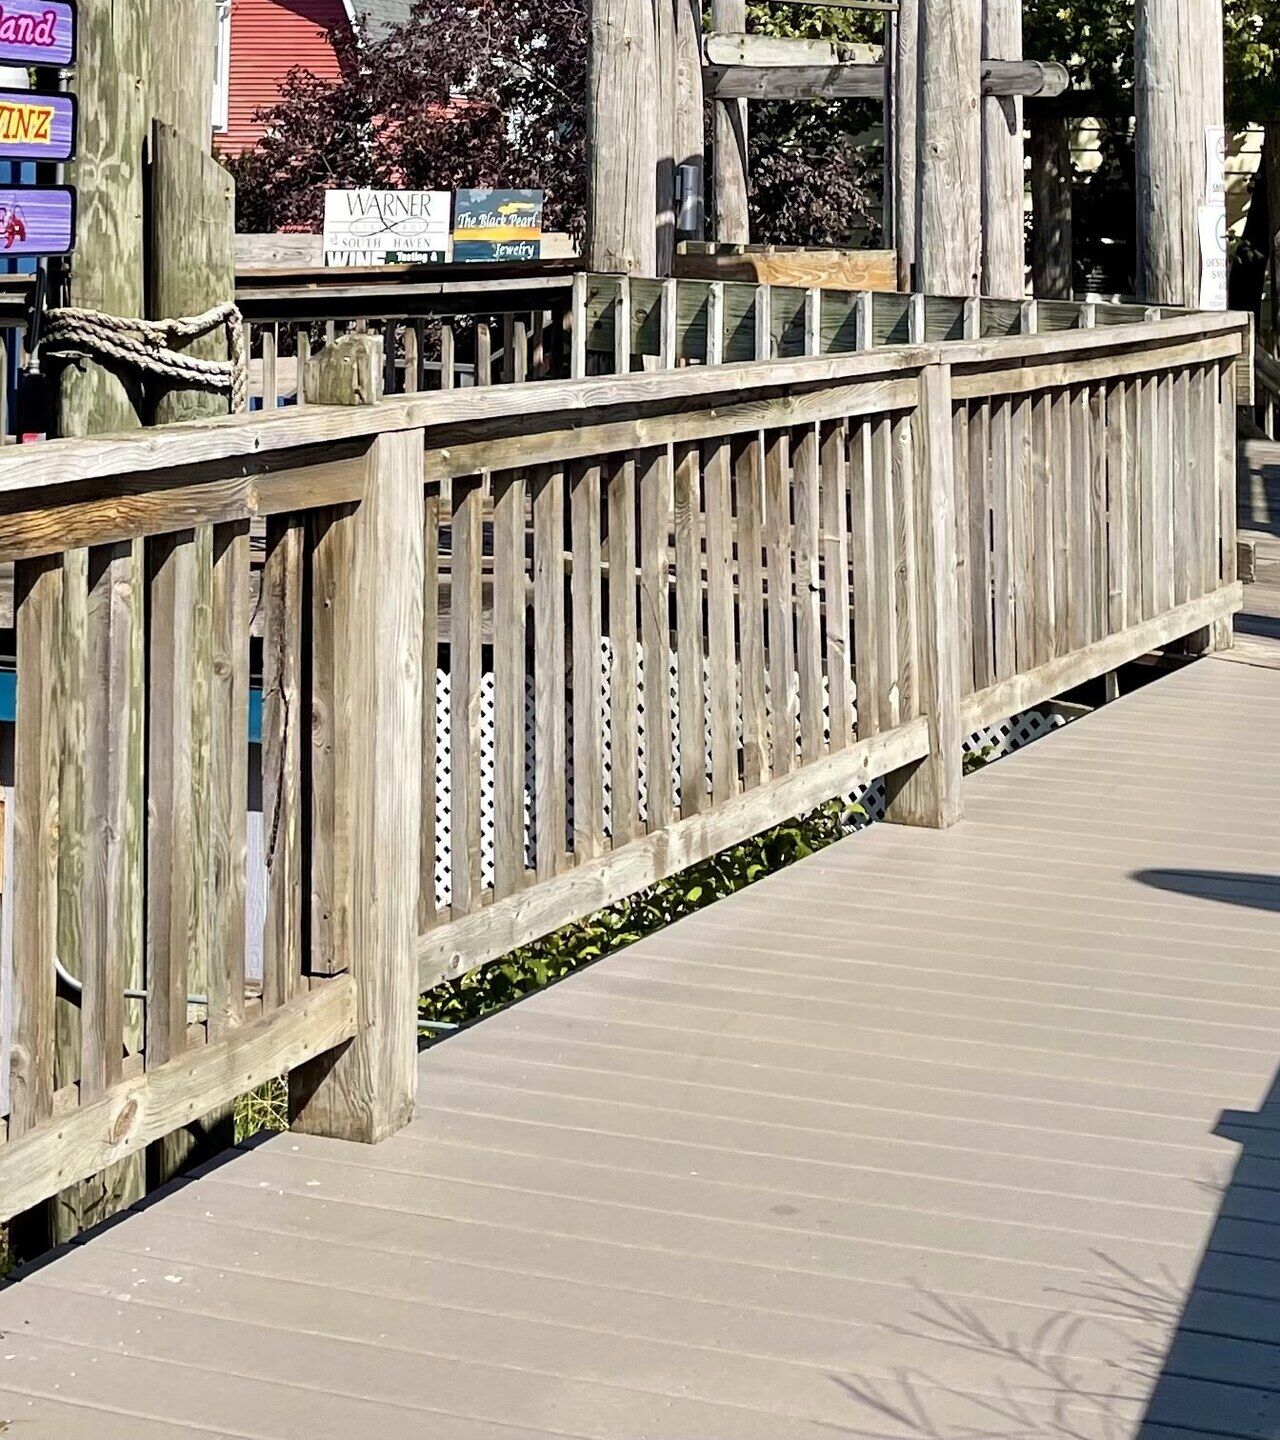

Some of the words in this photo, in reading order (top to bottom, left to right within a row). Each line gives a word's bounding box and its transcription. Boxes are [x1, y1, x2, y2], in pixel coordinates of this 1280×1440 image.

[346, 192, 431, 217] WARNER
[457, 212, 477, 228] The
[479, 212, 506, 228] Black
[508, 212, 538, 227] Pearl
[342, 237, 381, 248] SOUTH
[394, 237, 431, 248] HAVEN
[493, 241, 534, 259] Jewelry
[325, 251, 387, 266] WINE
